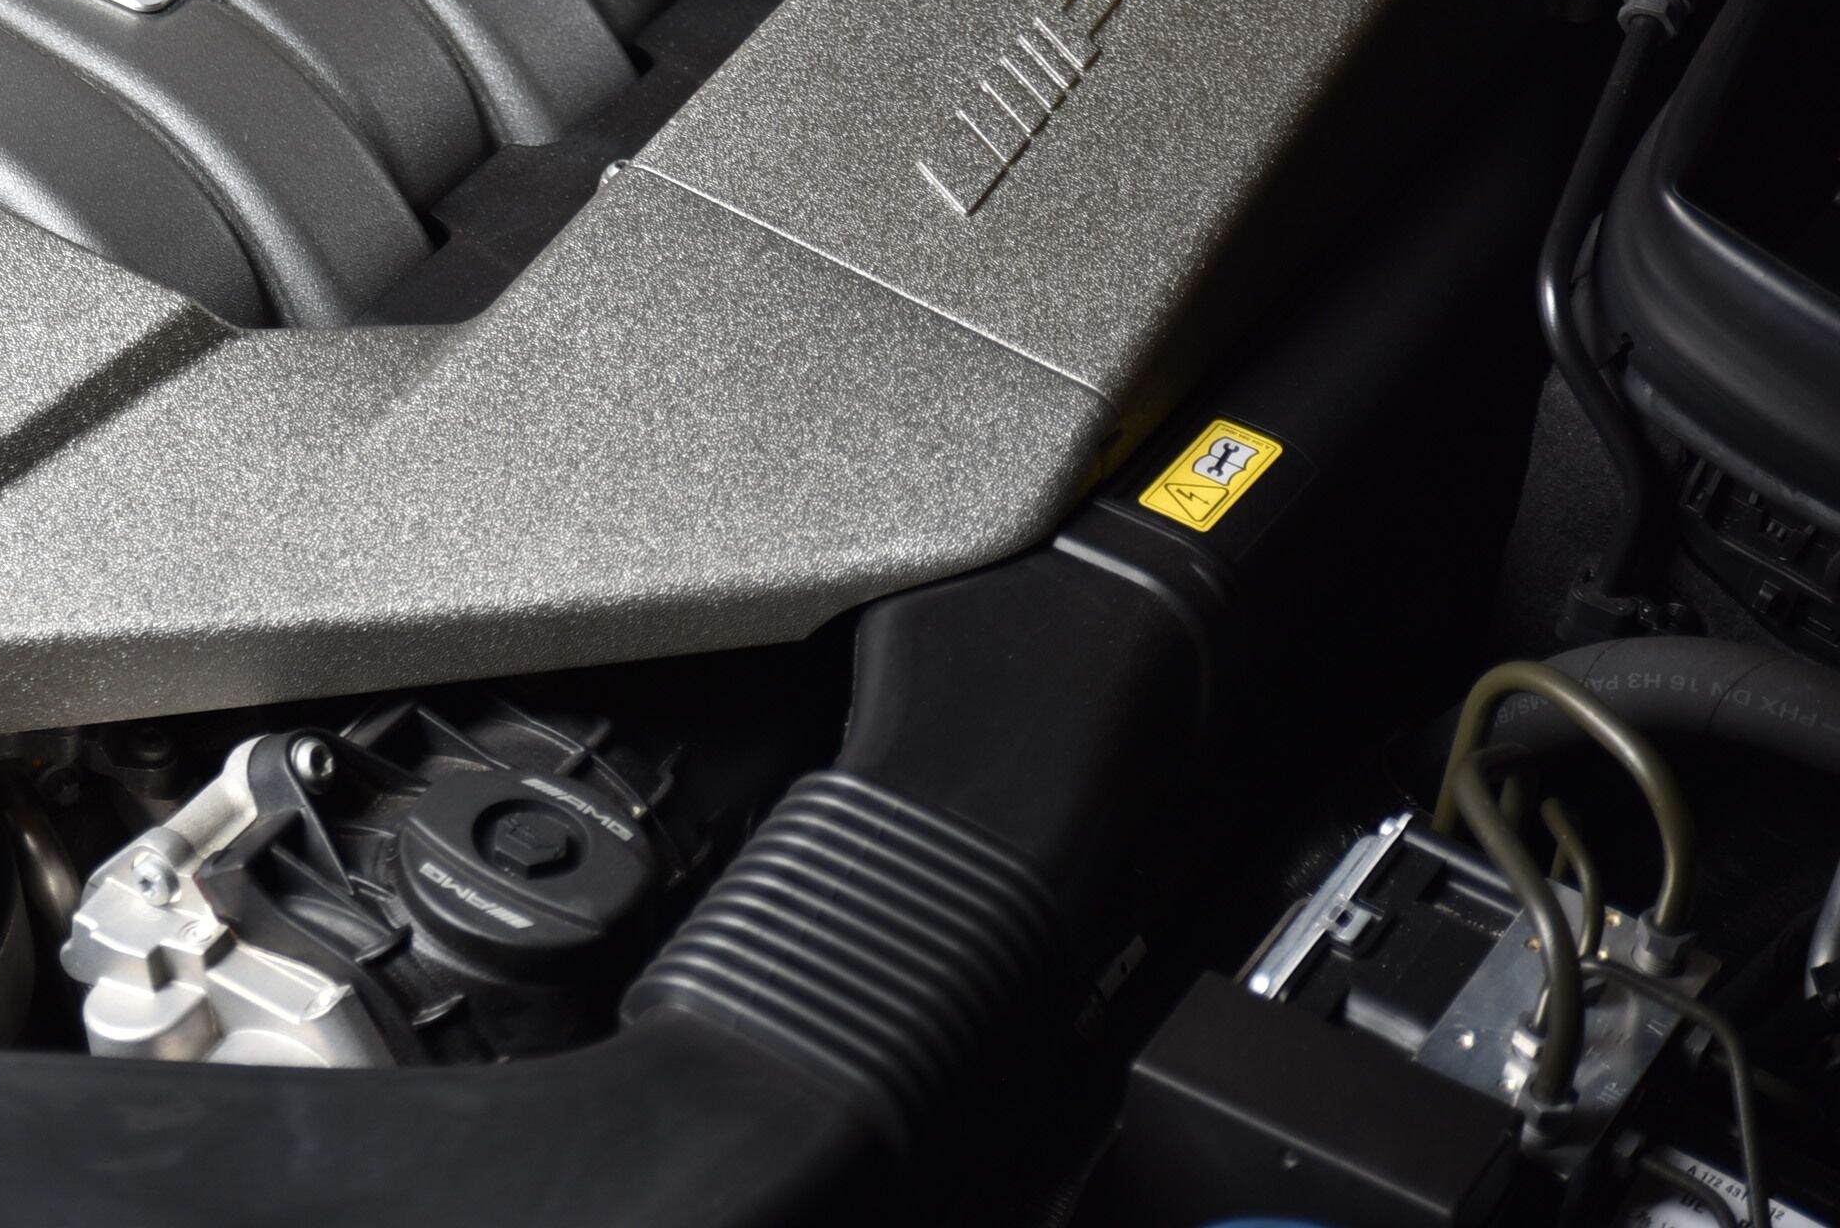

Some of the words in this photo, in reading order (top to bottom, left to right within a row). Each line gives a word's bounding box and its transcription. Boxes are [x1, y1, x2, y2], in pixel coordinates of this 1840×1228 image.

[1627, 672, 1661, 690] H3
[1670, 674, 1699, 692] 16
[521, 777, 635, 842] AMG
[419, 862, 535, 929] AMG
[1687, 1165, 1697, 1176] A
